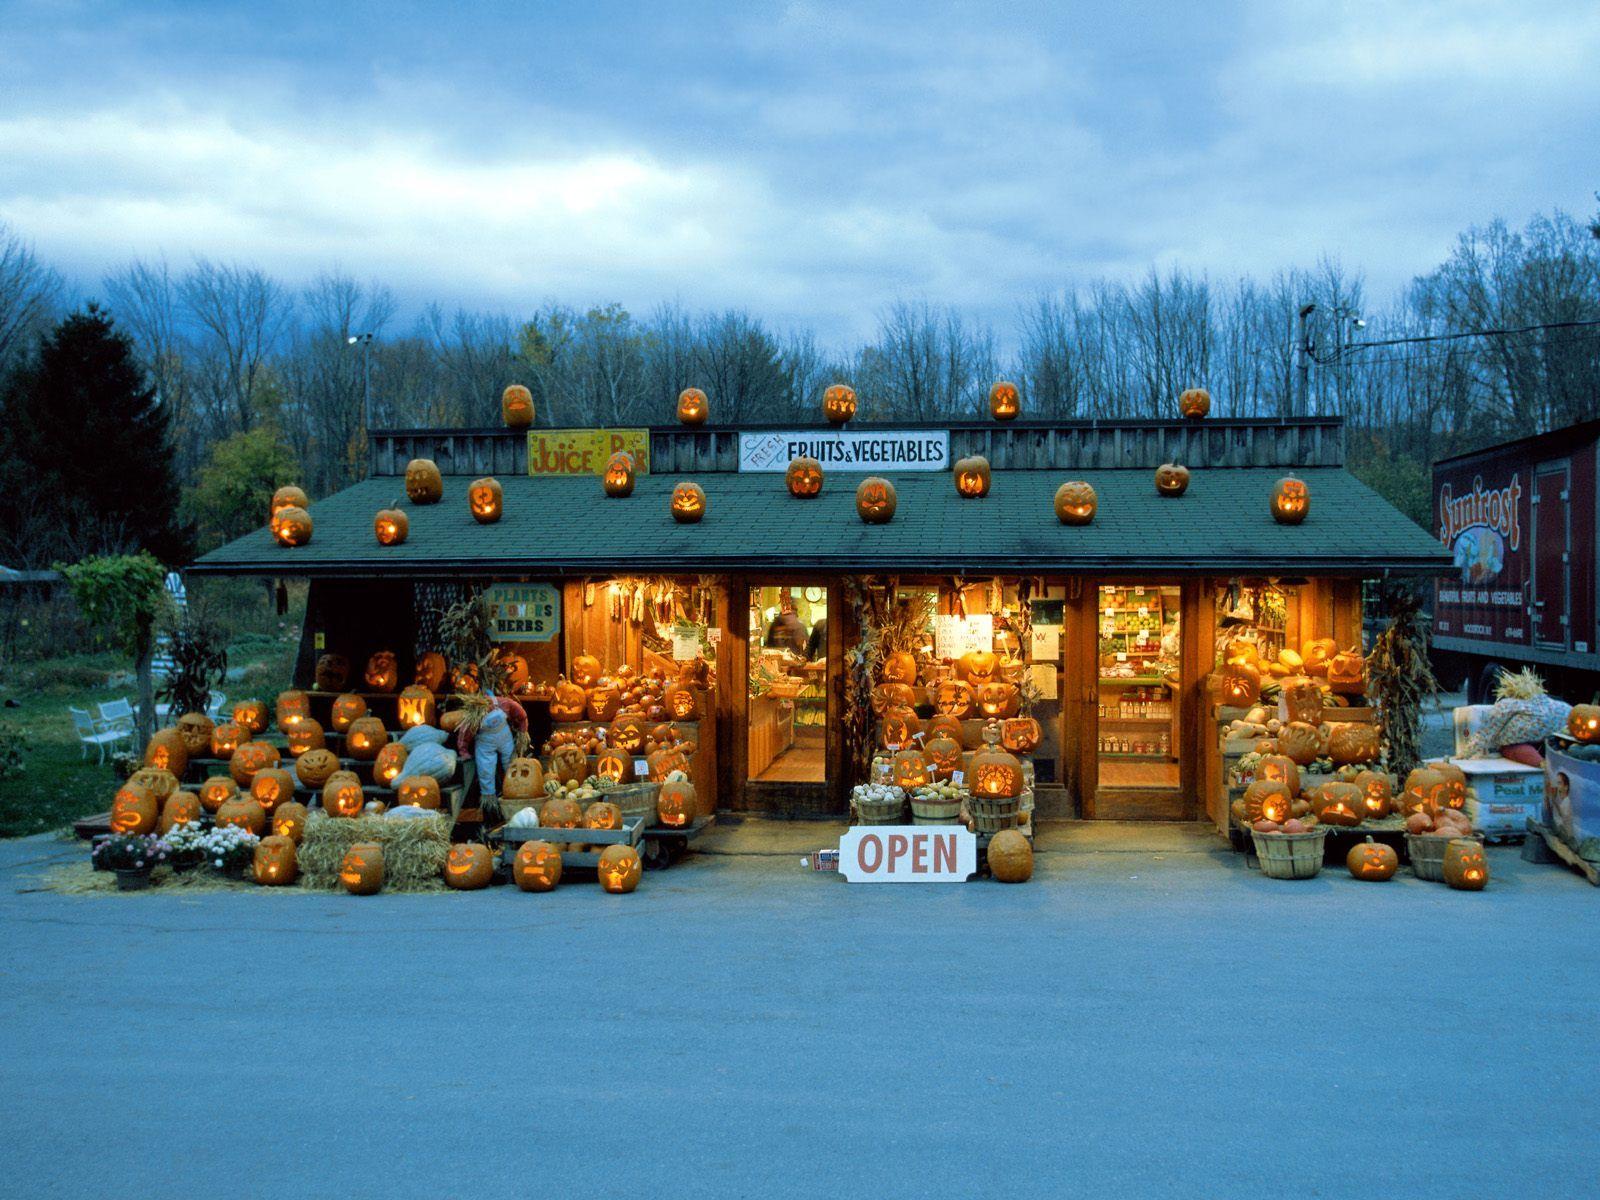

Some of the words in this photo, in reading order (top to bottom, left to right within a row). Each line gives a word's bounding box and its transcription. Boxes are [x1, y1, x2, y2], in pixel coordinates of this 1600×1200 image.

[751, 433, 786, 467] FRESH
[1440, 472, 1522, 552] Sunfrost
[494, 589, 548, 602] PLANTS
[1477, 591, 1489, 605] AND
[1490, 591, 1523, 606] VEGETABLES
[490, 603, 553, 617] FLOWERS
[497, 619, 544, 632] HERBS
[1494, 784, 1525, 795] Peat
[857, 834, 957, 874] OPEN
